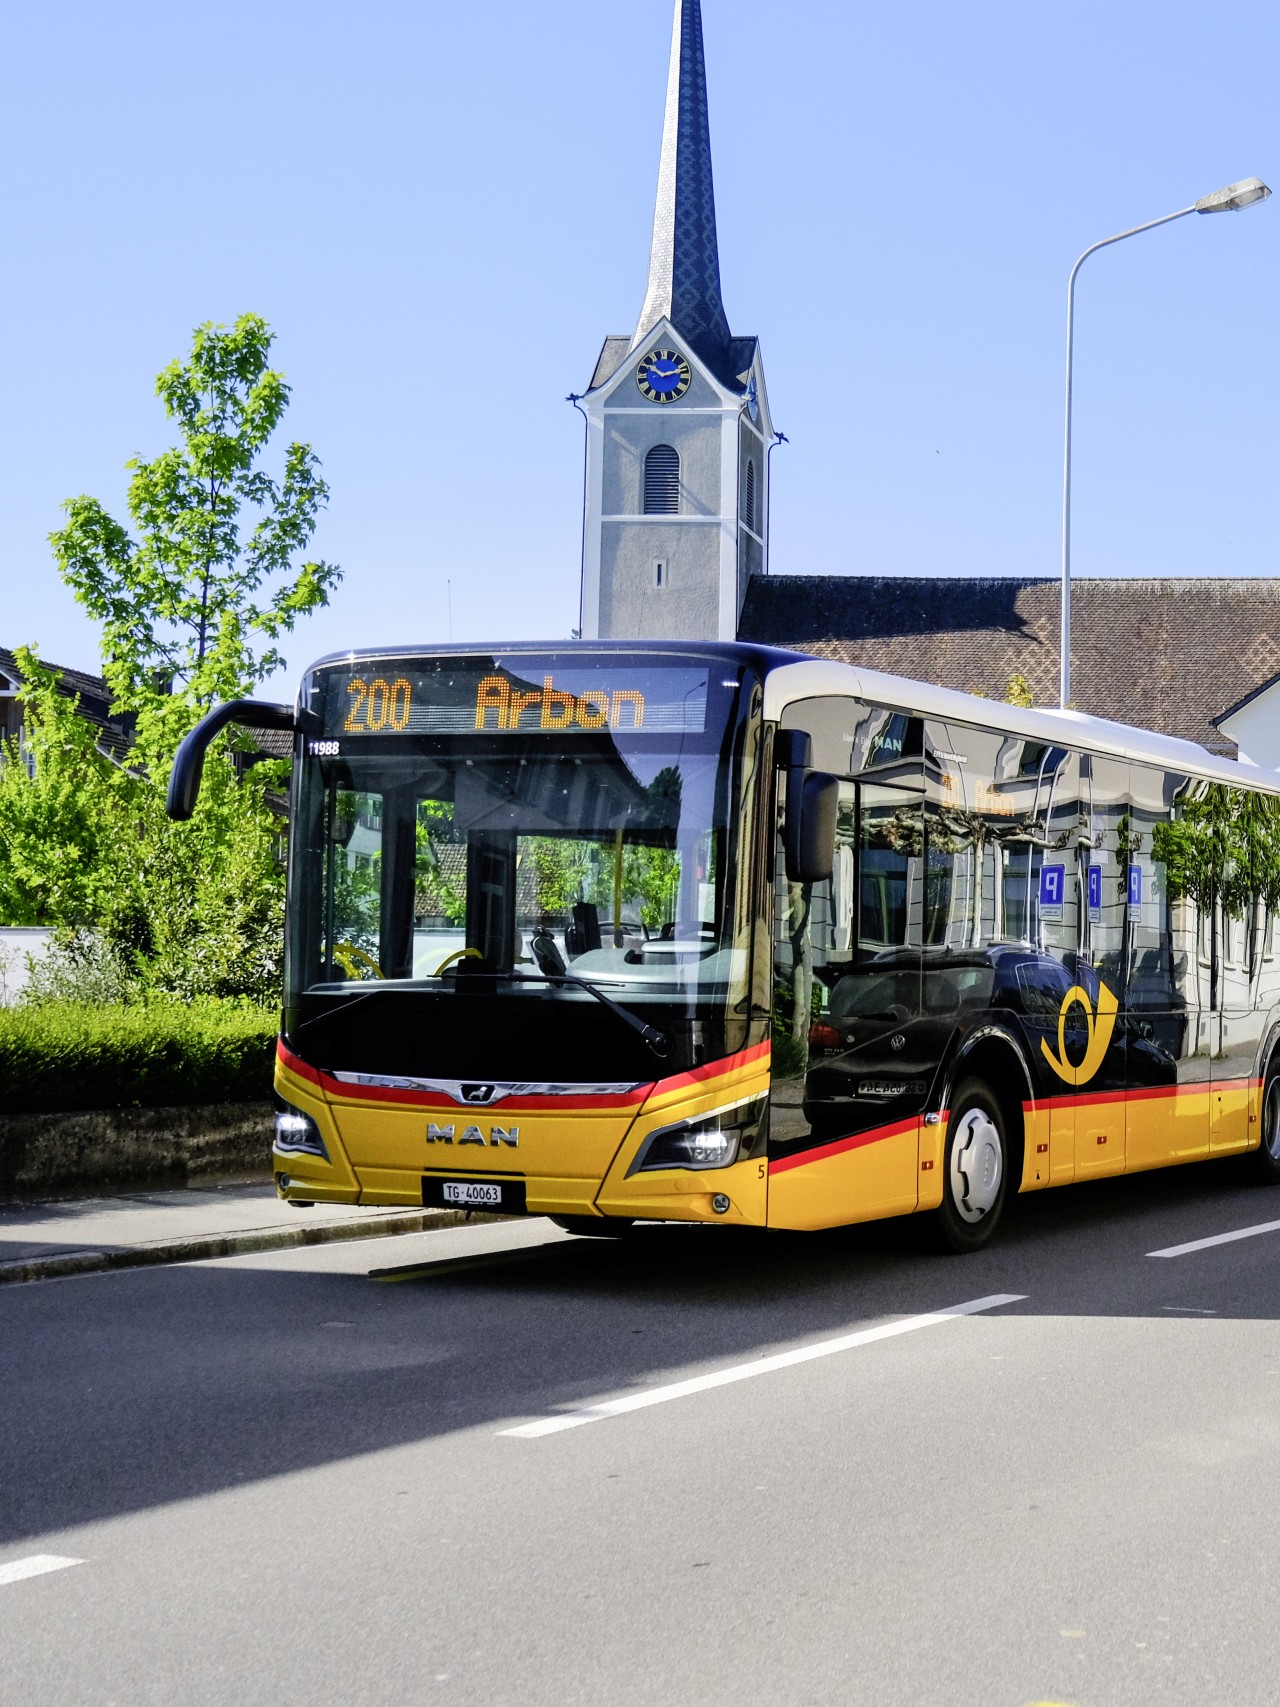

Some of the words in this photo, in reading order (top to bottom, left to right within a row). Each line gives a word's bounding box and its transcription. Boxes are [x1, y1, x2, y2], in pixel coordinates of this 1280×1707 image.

[344, 678, 412, 731] 200
[474, 675, 645, 729] Arbon
[308, 741, 340, 756] 11988
[874, 736, 902, 752] MAN
[426, 1123, 520, 1148] MAN
[758, 1164, 765, 1179] 5
